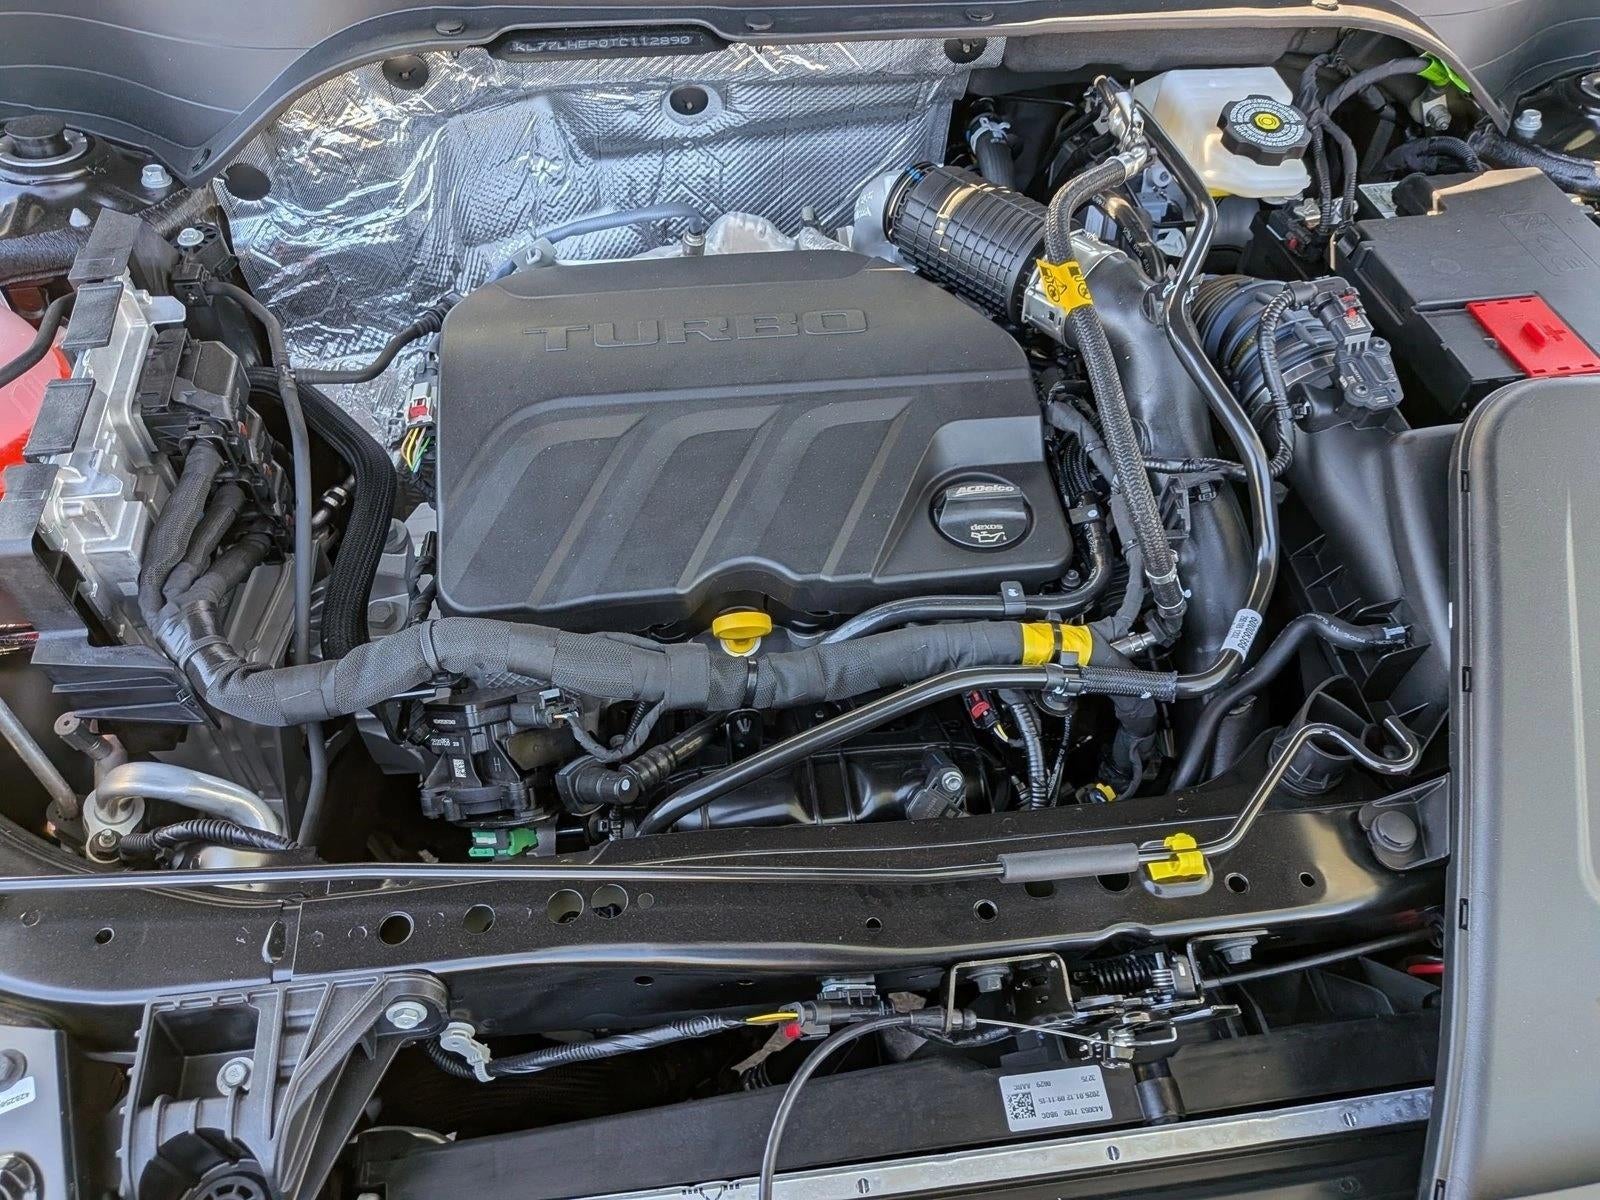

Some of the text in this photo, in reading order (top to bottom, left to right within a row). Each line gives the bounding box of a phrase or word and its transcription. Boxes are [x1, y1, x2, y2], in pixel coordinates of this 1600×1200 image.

[523, 309, 868, 352] TURBO
[955, 484, 1015, 497] ACDelco
[970, 523, 1004, 531] dexos
